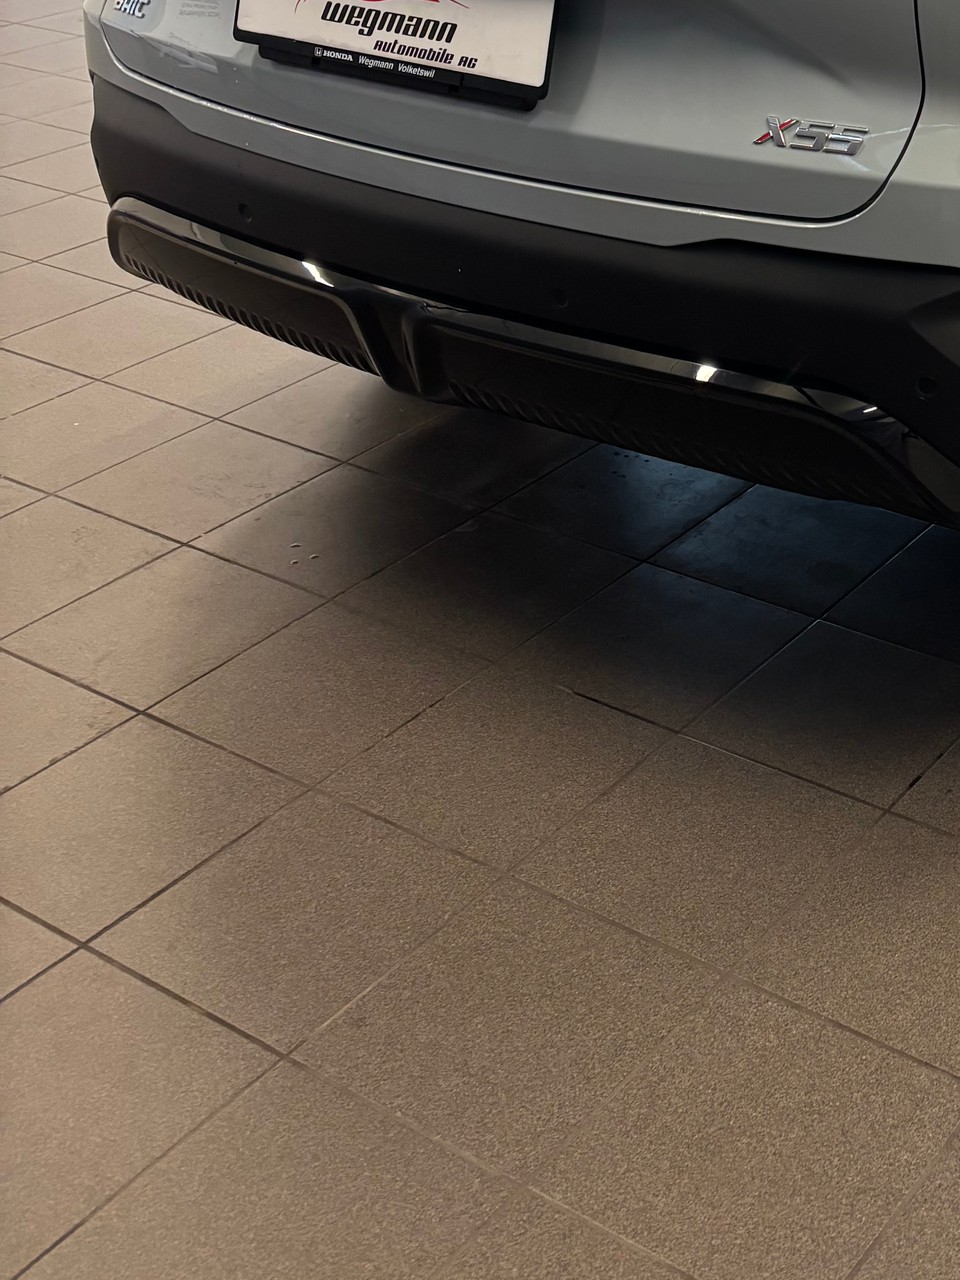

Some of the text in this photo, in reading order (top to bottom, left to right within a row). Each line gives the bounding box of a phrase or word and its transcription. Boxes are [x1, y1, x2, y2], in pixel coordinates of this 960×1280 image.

[321, 0, 458, 44] wegmann
[323, 49, 436, 79] HONDA Wegmann Volketswil
[458, 55, 479, 69] AG
[753, 115, 870, 157] X55
